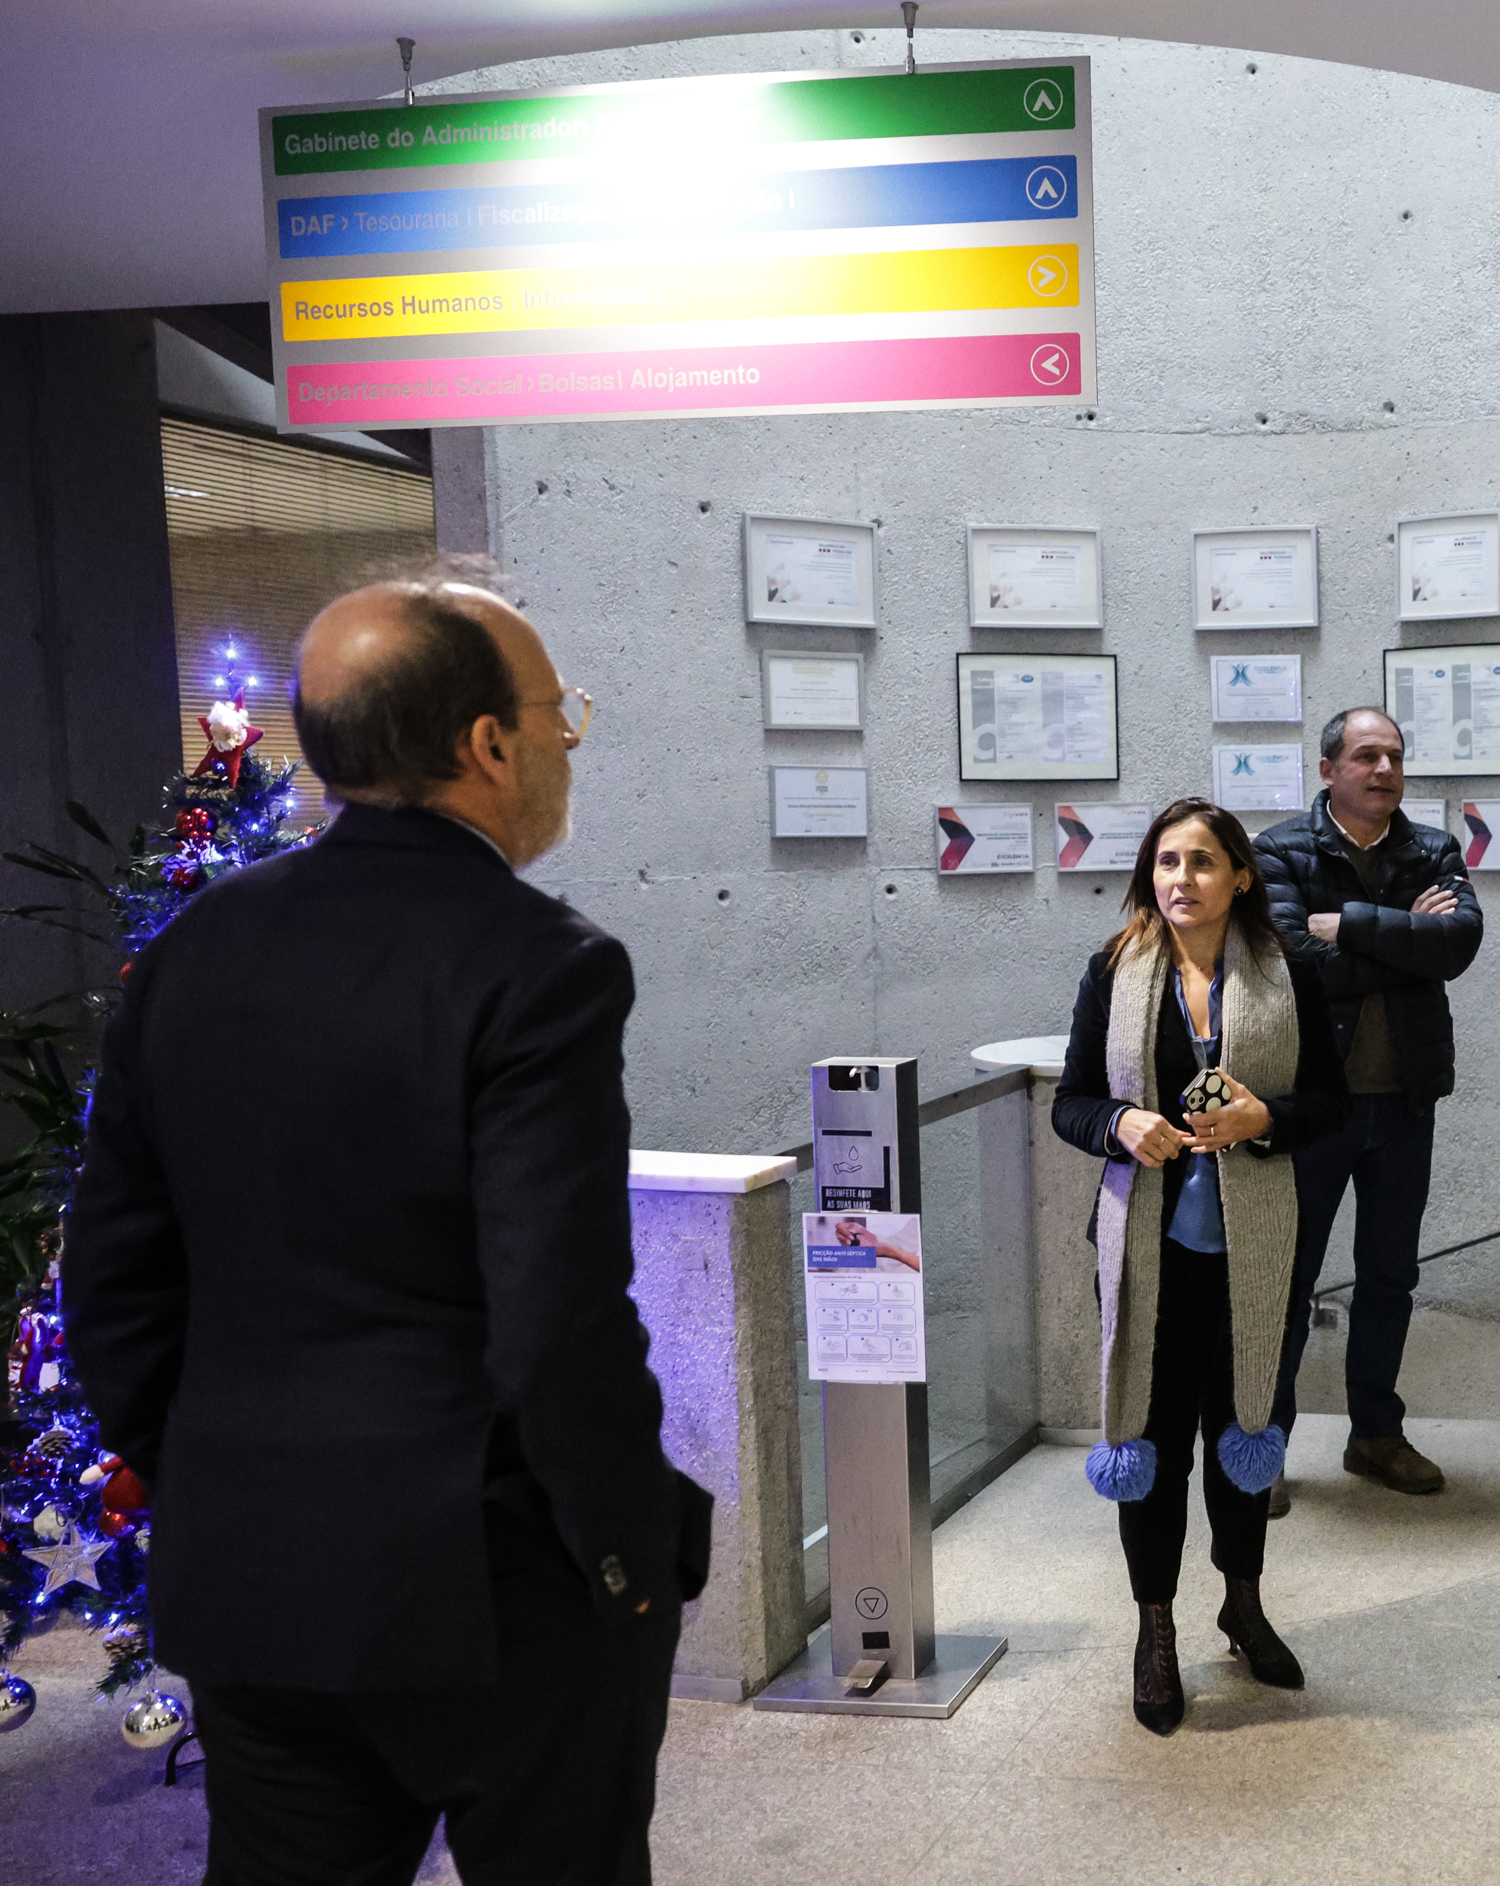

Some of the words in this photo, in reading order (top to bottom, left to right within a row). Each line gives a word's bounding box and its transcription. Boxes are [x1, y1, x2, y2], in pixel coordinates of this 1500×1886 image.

[284, 127, 380, 156] Gabinete
[386, 125, 415, 148] do
[421, 115, 579, 145] Administrador
[291, 213, 335, 236] DAF
[355, 208, 459, 233] Tesouraria
[295, 295, 395, 321] Recursos
[401, 290, 503, 315] Humanos
[300, 375, 448, 405] Departamento
[455, 372, 522, 397] Social
[539, 366, 614, 392] Bolsas
[631, 364, 760, 394] Alojamento
[827, 1200, 835, 1209] AS
